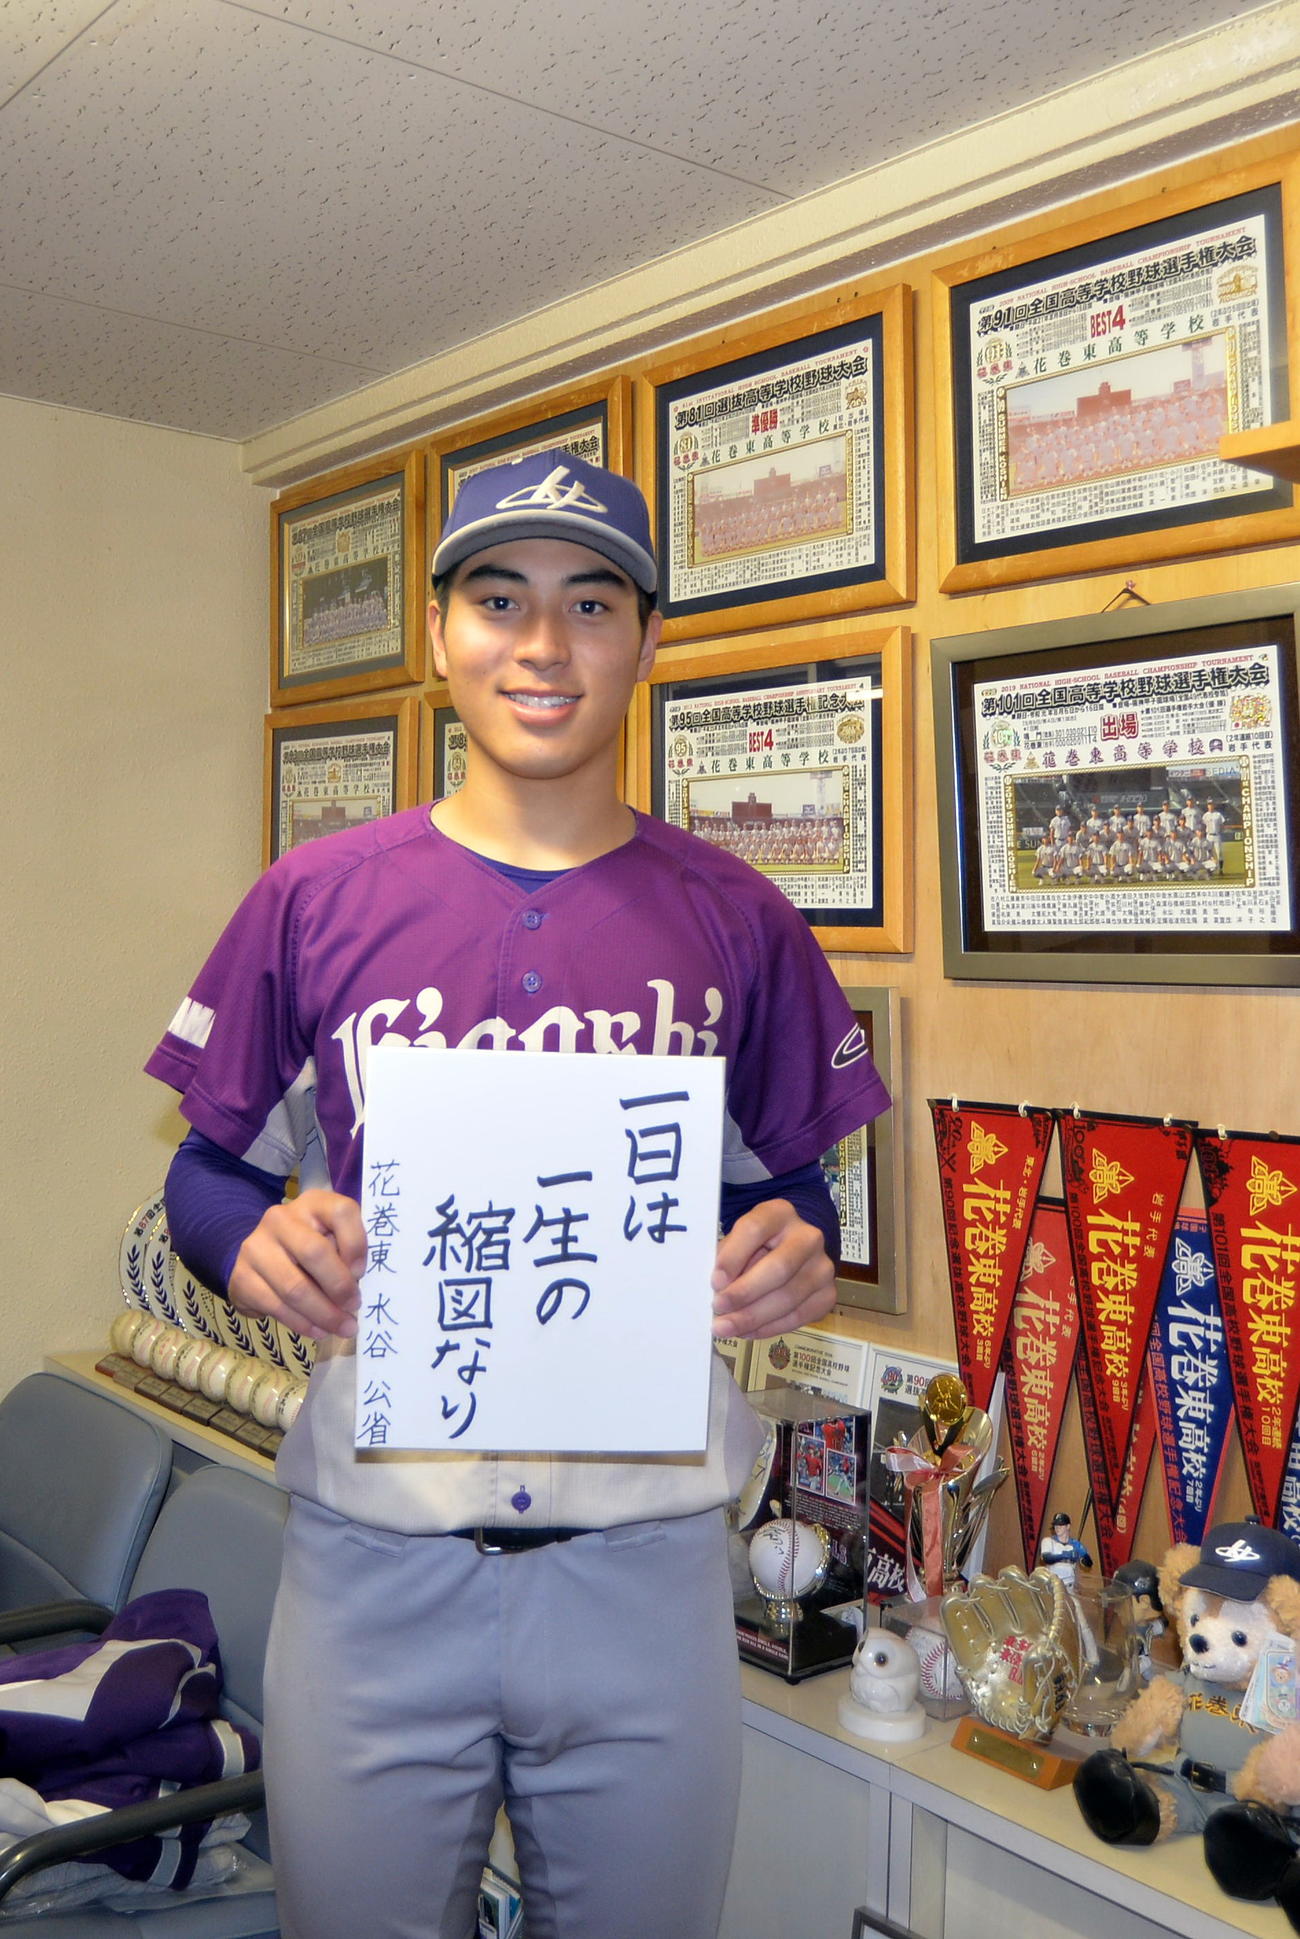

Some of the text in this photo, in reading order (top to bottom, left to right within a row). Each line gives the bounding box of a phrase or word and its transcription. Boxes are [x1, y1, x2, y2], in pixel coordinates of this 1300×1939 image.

[978, 235, 1257, 332] 第91回全国高等学校野球選手権大会
[675, 355, 868, 430] 第81回選抜高等学校野球大会
[1035, 314, 1204, 374] 花巻東高等学校
[712, 418, 829, 464] 花巻東高等学校
[982, 662, 1269, 717] 第101回全国高等学校野球選手権大会
[1020, 681, 1051, 689] NATIONAL
[1055, 674, 1101, 685] HIGH-SCHOOL
[1104, 668, 1139, 679] BASEBALL
[1143, 662, 1198, 674] CHAMPIONSHIP
[1202, 655, 1254, 666] TOURNAMENT
[712, 749, 829, 773] 花巻東高等学校
[1042, 738, 1205, 768] 花巻東高等学校
[1101, 711, 1139, 741] 出場
[1241, 788, 1254, 887] CHAMPIONSHIP
[619, 1090, 691, 1244] 一日は
[366, 1158, 402, 1276] 花巻東
[522, 1170, 599, 1326] 一生の
[963, 1177, 1011, 1338] 花巻東高校
[1143, 1192, 1165, 1258] 岩手代表
[422, 1193, 517, 1440] 縮図なり
[1086, 1208, 1141, 1378] 花巻東高校
[1240, 1220, 1300, 1405] 花巻東高校
[1013, 1286, 1060, 1449] 花巻東高校
[1167, 1299, 1222, 1478] 花巻東高校
[867, 1548, 905, 1592] 高校
